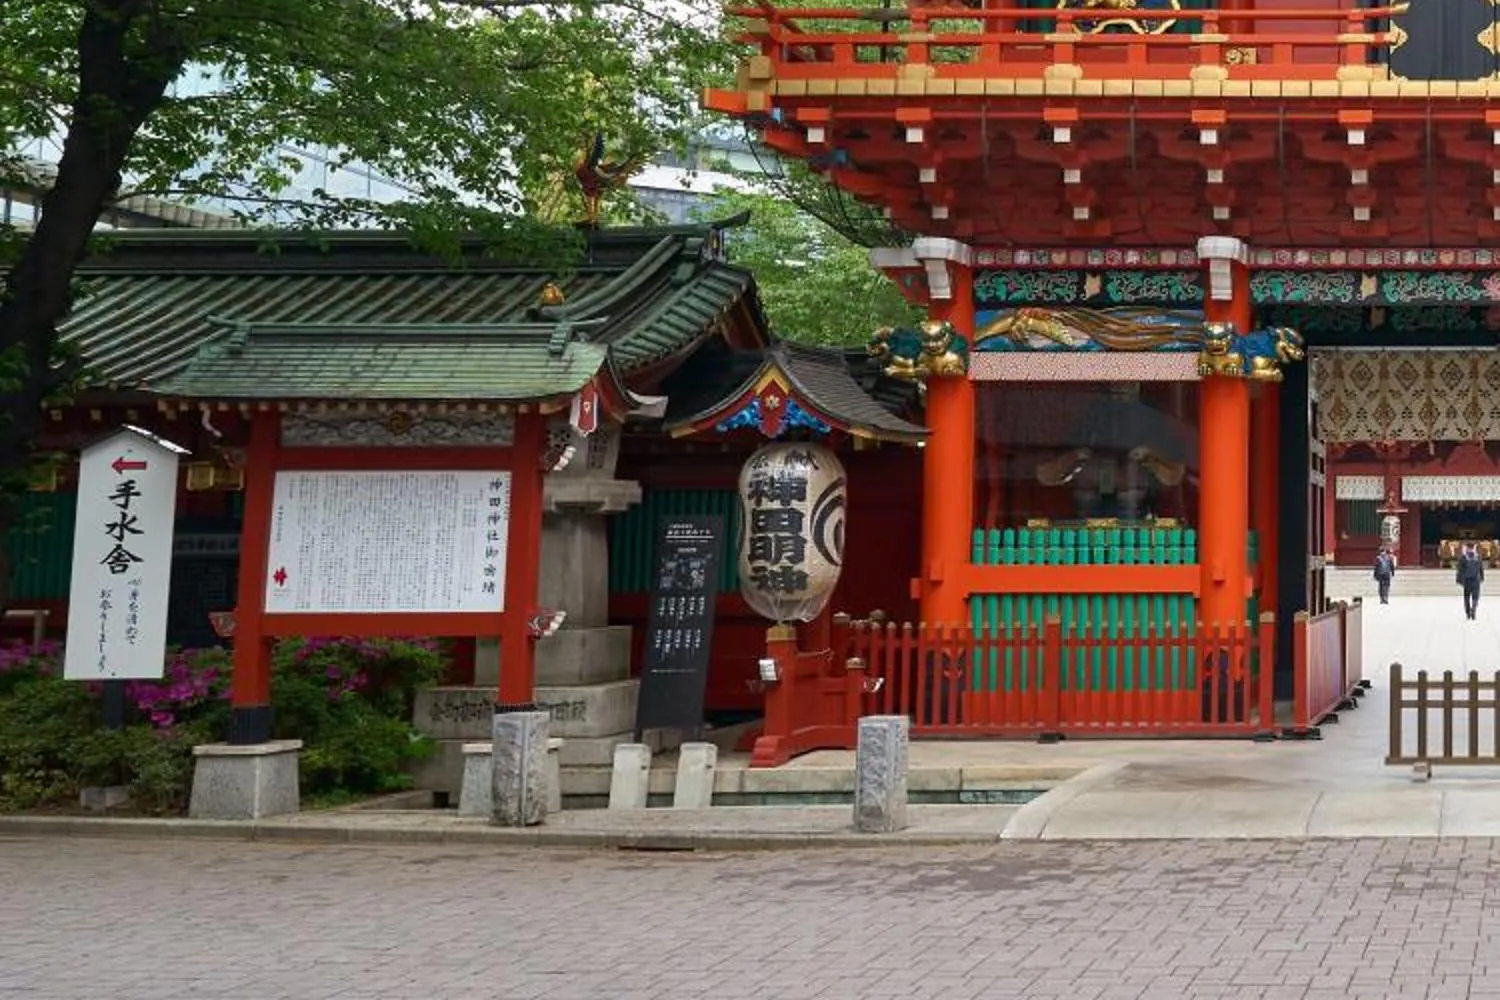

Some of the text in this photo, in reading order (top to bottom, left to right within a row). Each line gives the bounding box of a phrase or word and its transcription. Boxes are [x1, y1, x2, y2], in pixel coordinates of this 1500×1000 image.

[99, 479, 145, 575] 手水舎
[748, 472, 808, 592] 神田明神
